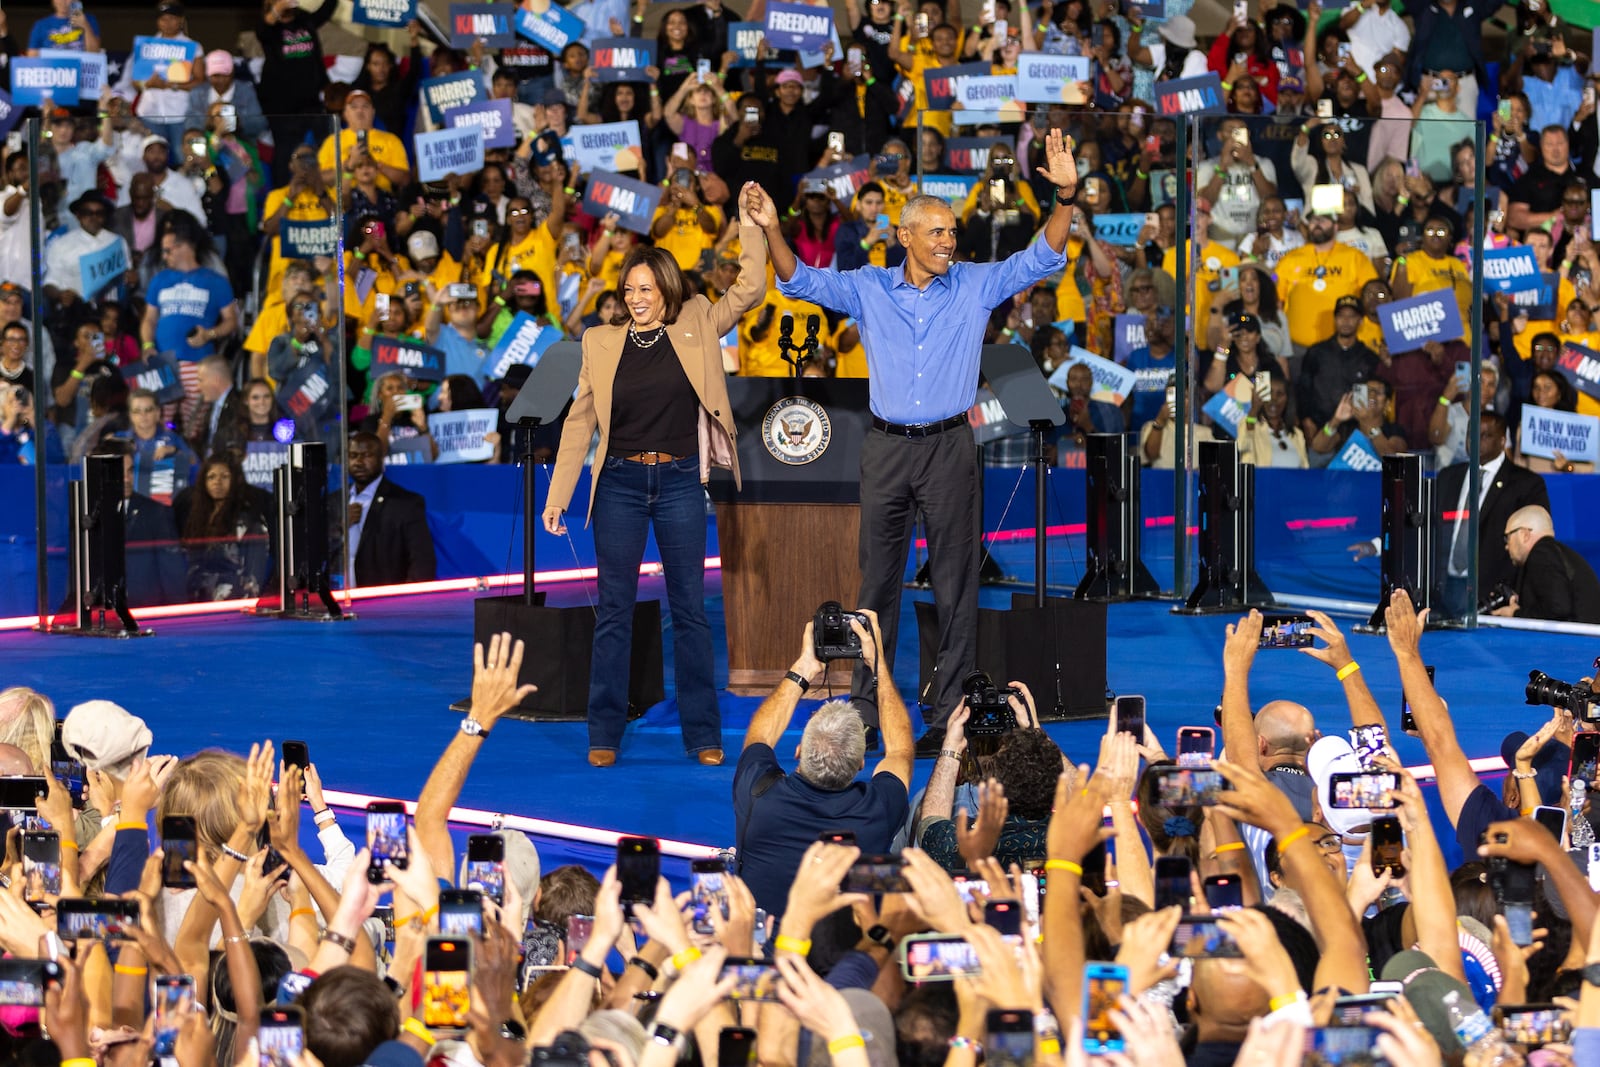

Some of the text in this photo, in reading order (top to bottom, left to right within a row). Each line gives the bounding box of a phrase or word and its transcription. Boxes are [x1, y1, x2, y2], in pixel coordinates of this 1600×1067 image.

[366, 9, 402, 22] WALZ
[455, 14, 509, 35] KAMALA
[768, 11, 829, 35] FREEDOM
[736, 30, 765, 49] HAR
[595, 48, 650, 68] KAMALA
[743, 48, 779, 60] WLZ
[16, 67, 77, 88] FREEDOM
[1029, 62, 1079, 79] GEORGIA
[429, 78, 478, 106] HARRIS
[966, 83, 1016, 101] GEORGIA
[1160, 86, 1220, 114] KAMALA
[425, 134, 480, 157] A NEW WAY
[581, 131, 629, 149] GEORGIA
[429, 150, 478, 171] FORWARD
[590, 181, 650, 218] KAMALA
[922, 182, 968, 199] EORGIA
[1094, 221, 1139, 238] ote
[1391, 301, 1446, 332] HARRIS
[1402, 321, 1441, 342] WALZ
[377, 346, 440, 369] KAMALA
[763, 402, 784, 442] PRESIDENT
[810, 403, 829, 432] UNITED
[1528, 415, 1591, 439] A NEW WAY
[443, 421, 465, 436] NEW
[807, 435, 829, 461] STATES
[1531, 432, 1586, 453] FORWARD
[1275, 766, 1305, 776] SONY
